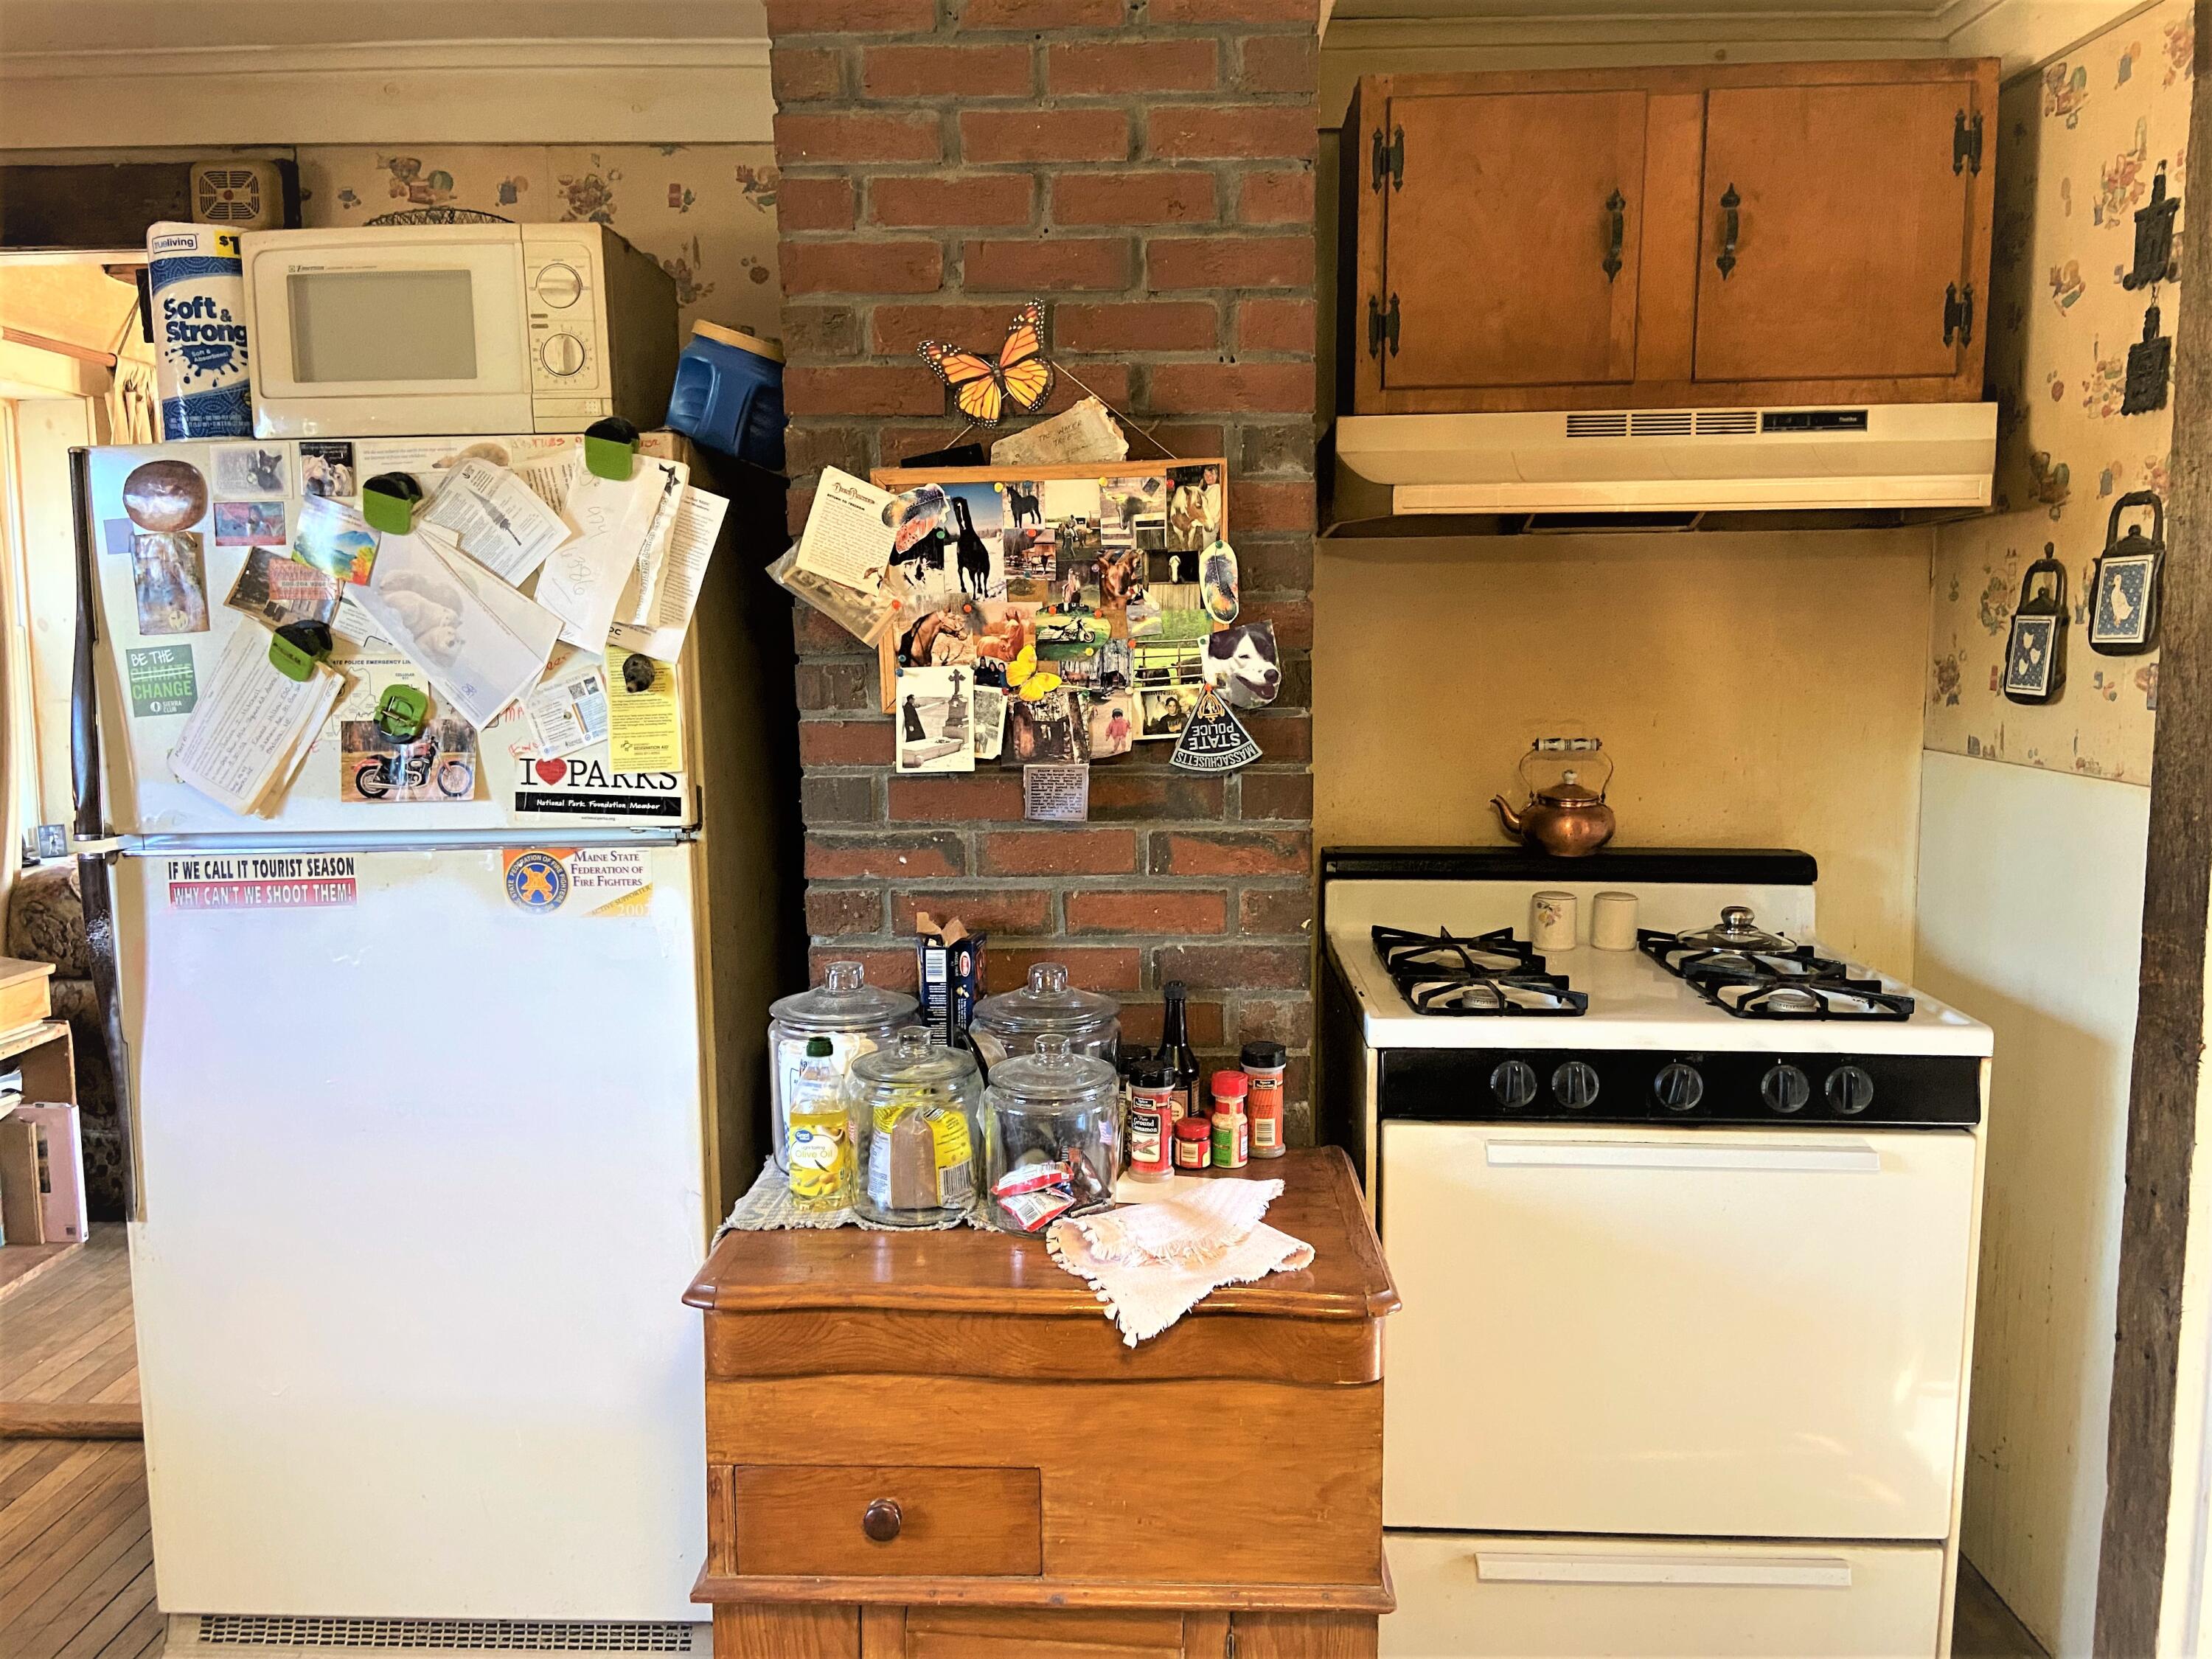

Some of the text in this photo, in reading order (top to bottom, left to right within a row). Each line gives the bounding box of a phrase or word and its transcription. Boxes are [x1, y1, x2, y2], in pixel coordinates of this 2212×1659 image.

[164, 296, 232, 322] Soft &
[166, 321, 248, 347] Strong
[131, 649, 175, 667] BE THE
[133, 680, 193, 700] CHANGE
[1191, 722, 1235, 737] POLICE
[1188, 733, 1242, 751] STATE
[1175, 745, 1256, 768] MASSACHUSETTS
[519, 757, 538, 786] I
[536, 799, 661, 810] National Park Foundation Member
[574, 849, 640, 862] MAINE STATE
[168, 857, 355, 880] IF WE CALL IT TOURIST SEASON
[571, 863, 644, 875] FEDERATION OF
[573, 875, 643, 887] FIRE FIGHTERS
[173, 883, 352, 906] WHY CAN'T WE SHOOT THEM!
[615, 884, 652, 905] SUPPORTER
[1133, 1117, 1155, 1127] Ground
[795, 1149, 833, 1158] Olive Oil
